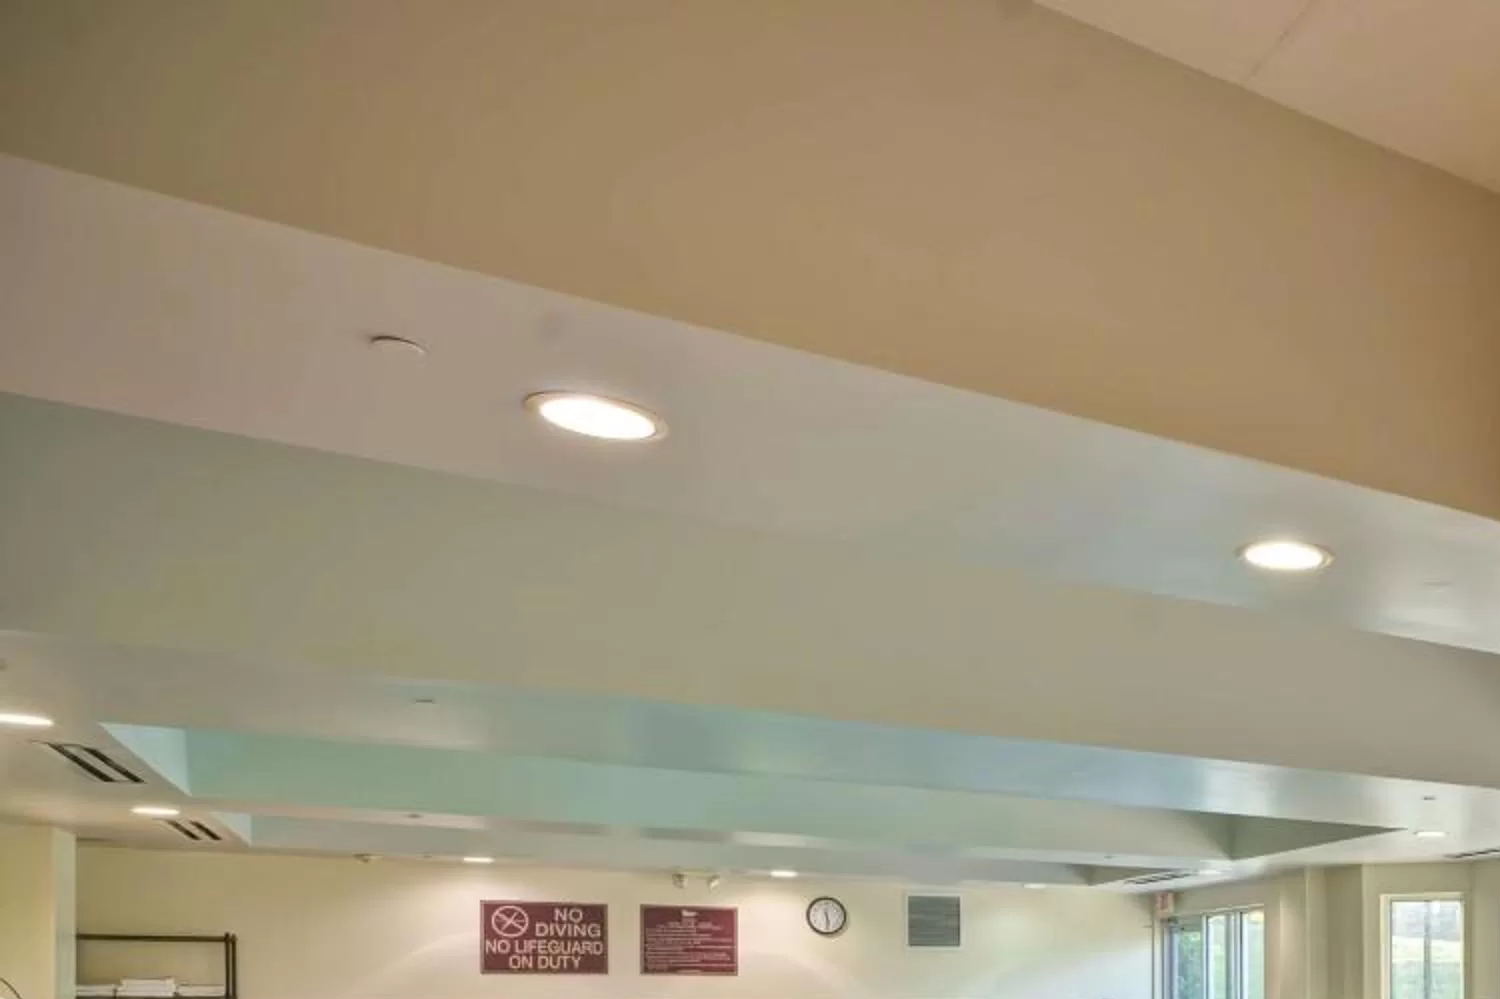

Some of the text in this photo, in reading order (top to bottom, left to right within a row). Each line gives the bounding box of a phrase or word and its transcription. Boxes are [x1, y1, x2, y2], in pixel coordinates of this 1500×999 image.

[553, 907, 583, 922] NO
[535, 923, 601, 938] DIVING
[485, 938, 604, 955] NO LIFEGUARD
[508, 956, 581, 969] ON DUTY
